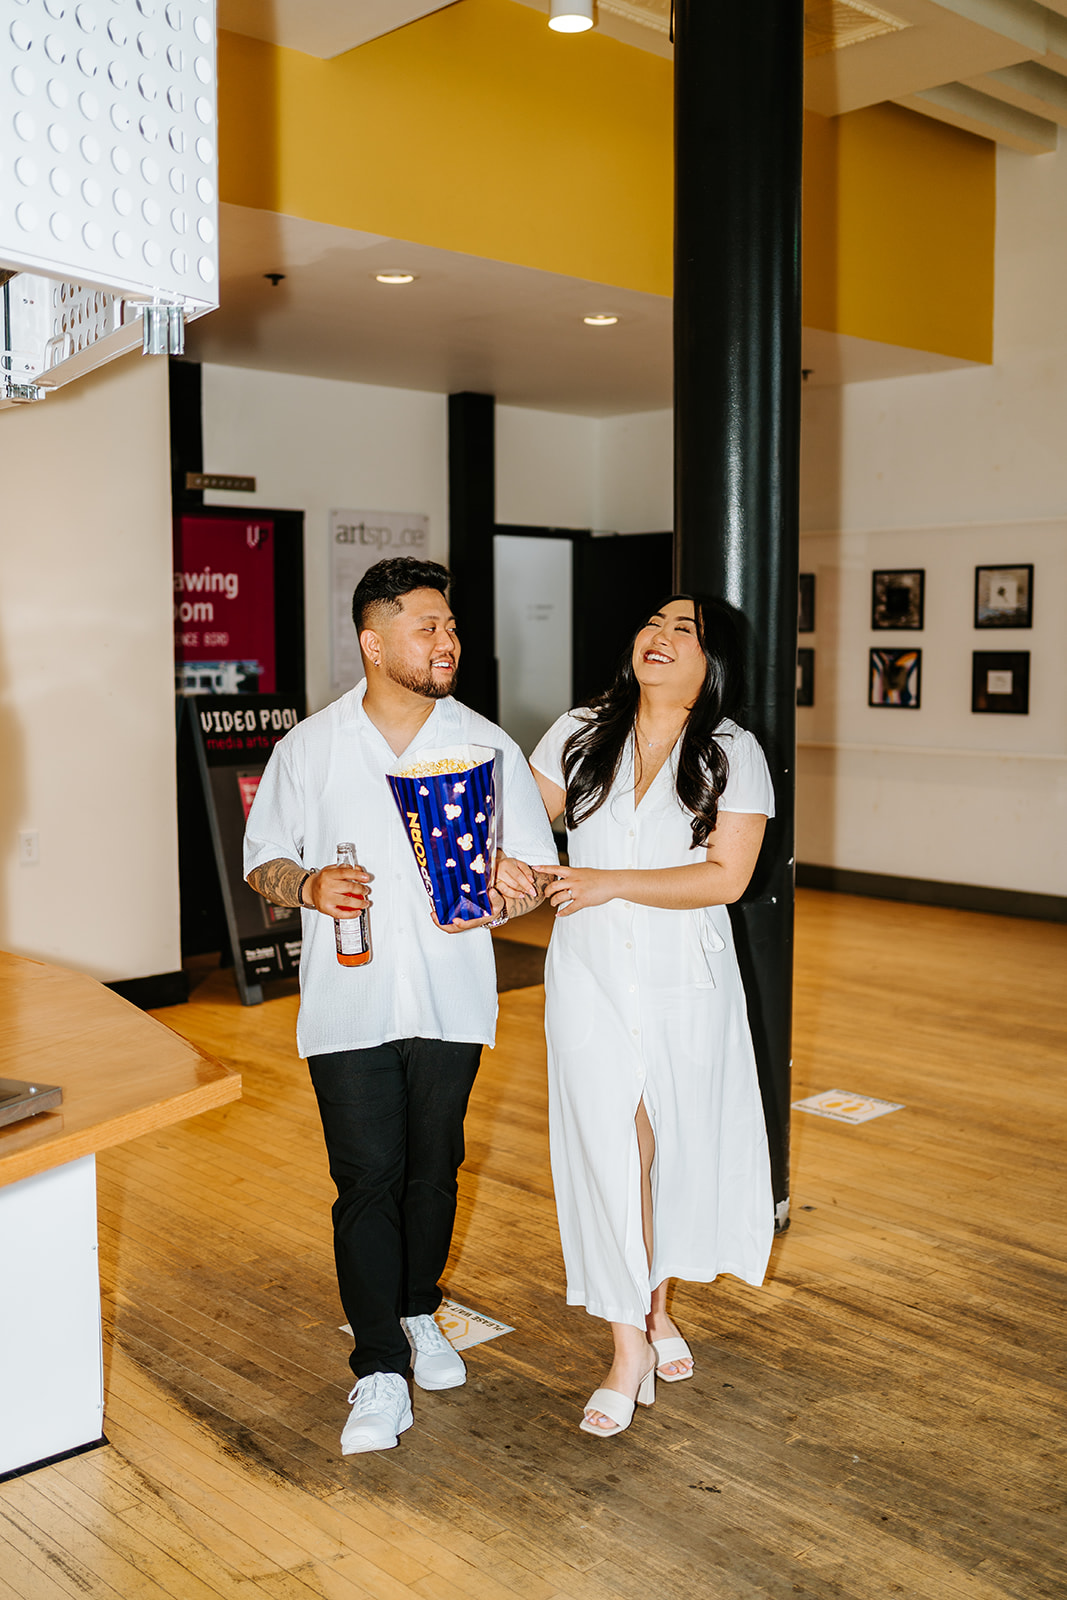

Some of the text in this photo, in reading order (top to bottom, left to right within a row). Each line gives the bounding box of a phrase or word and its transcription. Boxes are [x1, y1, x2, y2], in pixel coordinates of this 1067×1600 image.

[200, 709, 257, 733] VIDEO
[207, 735, 244, 750] media
[246, 734, 270, 750] arts
[450, 1306, 473, 1319] WAIT
[471, 1315, 505, 1331] PLEASE
